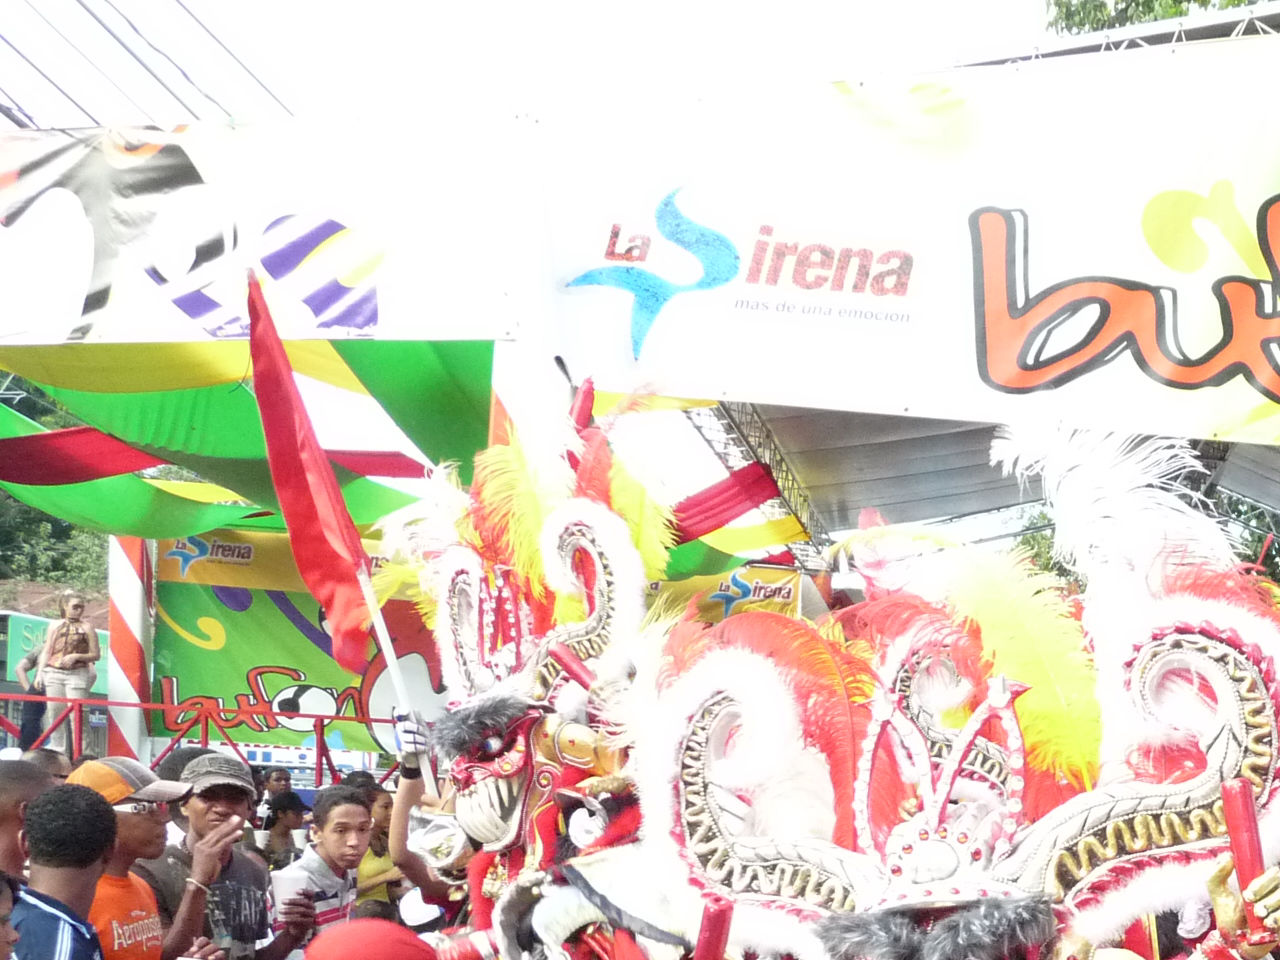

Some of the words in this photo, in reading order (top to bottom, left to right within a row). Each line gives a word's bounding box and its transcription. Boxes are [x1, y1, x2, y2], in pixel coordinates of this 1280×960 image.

[604, 223, 651, 262] La
[775, 301, 797, 314] de
[801, 304, 833, 317] una
[175, 539, 187, 550] La
[718, 582, 731, 593] La
